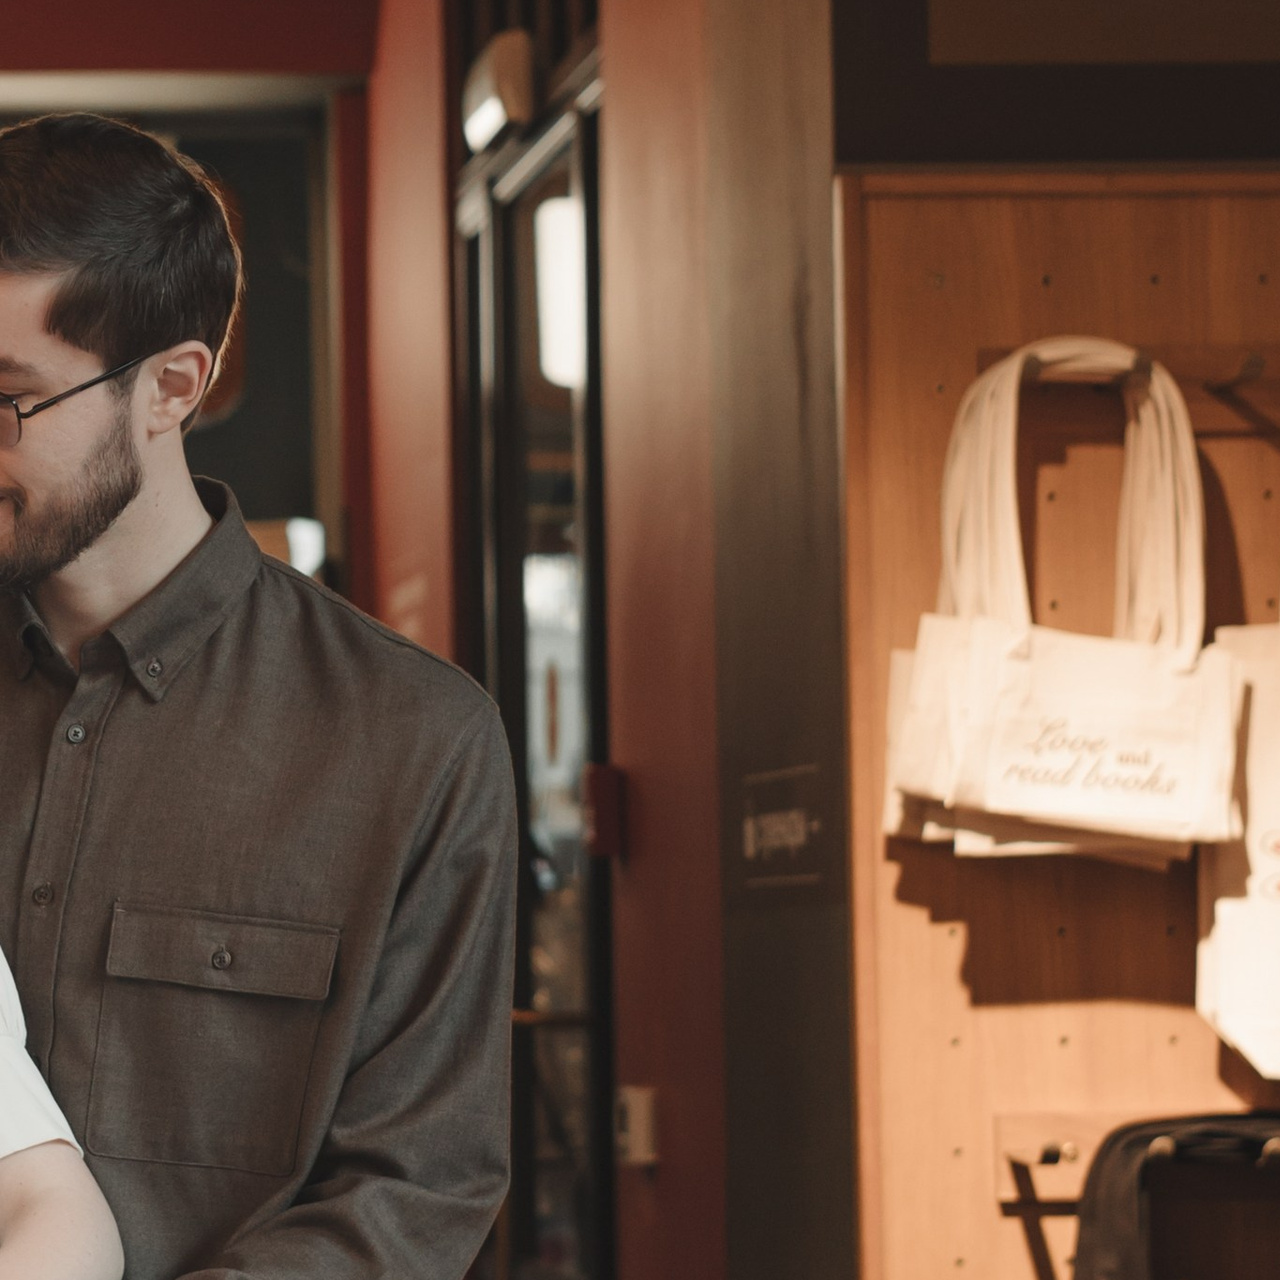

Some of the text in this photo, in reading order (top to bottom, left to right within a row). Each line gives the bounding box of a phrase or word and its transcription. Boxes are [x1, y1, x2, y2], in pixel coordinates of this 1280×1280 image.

[1024, 716, 1151, 766] Love and
[1002, 753, 1177, 795] read books
